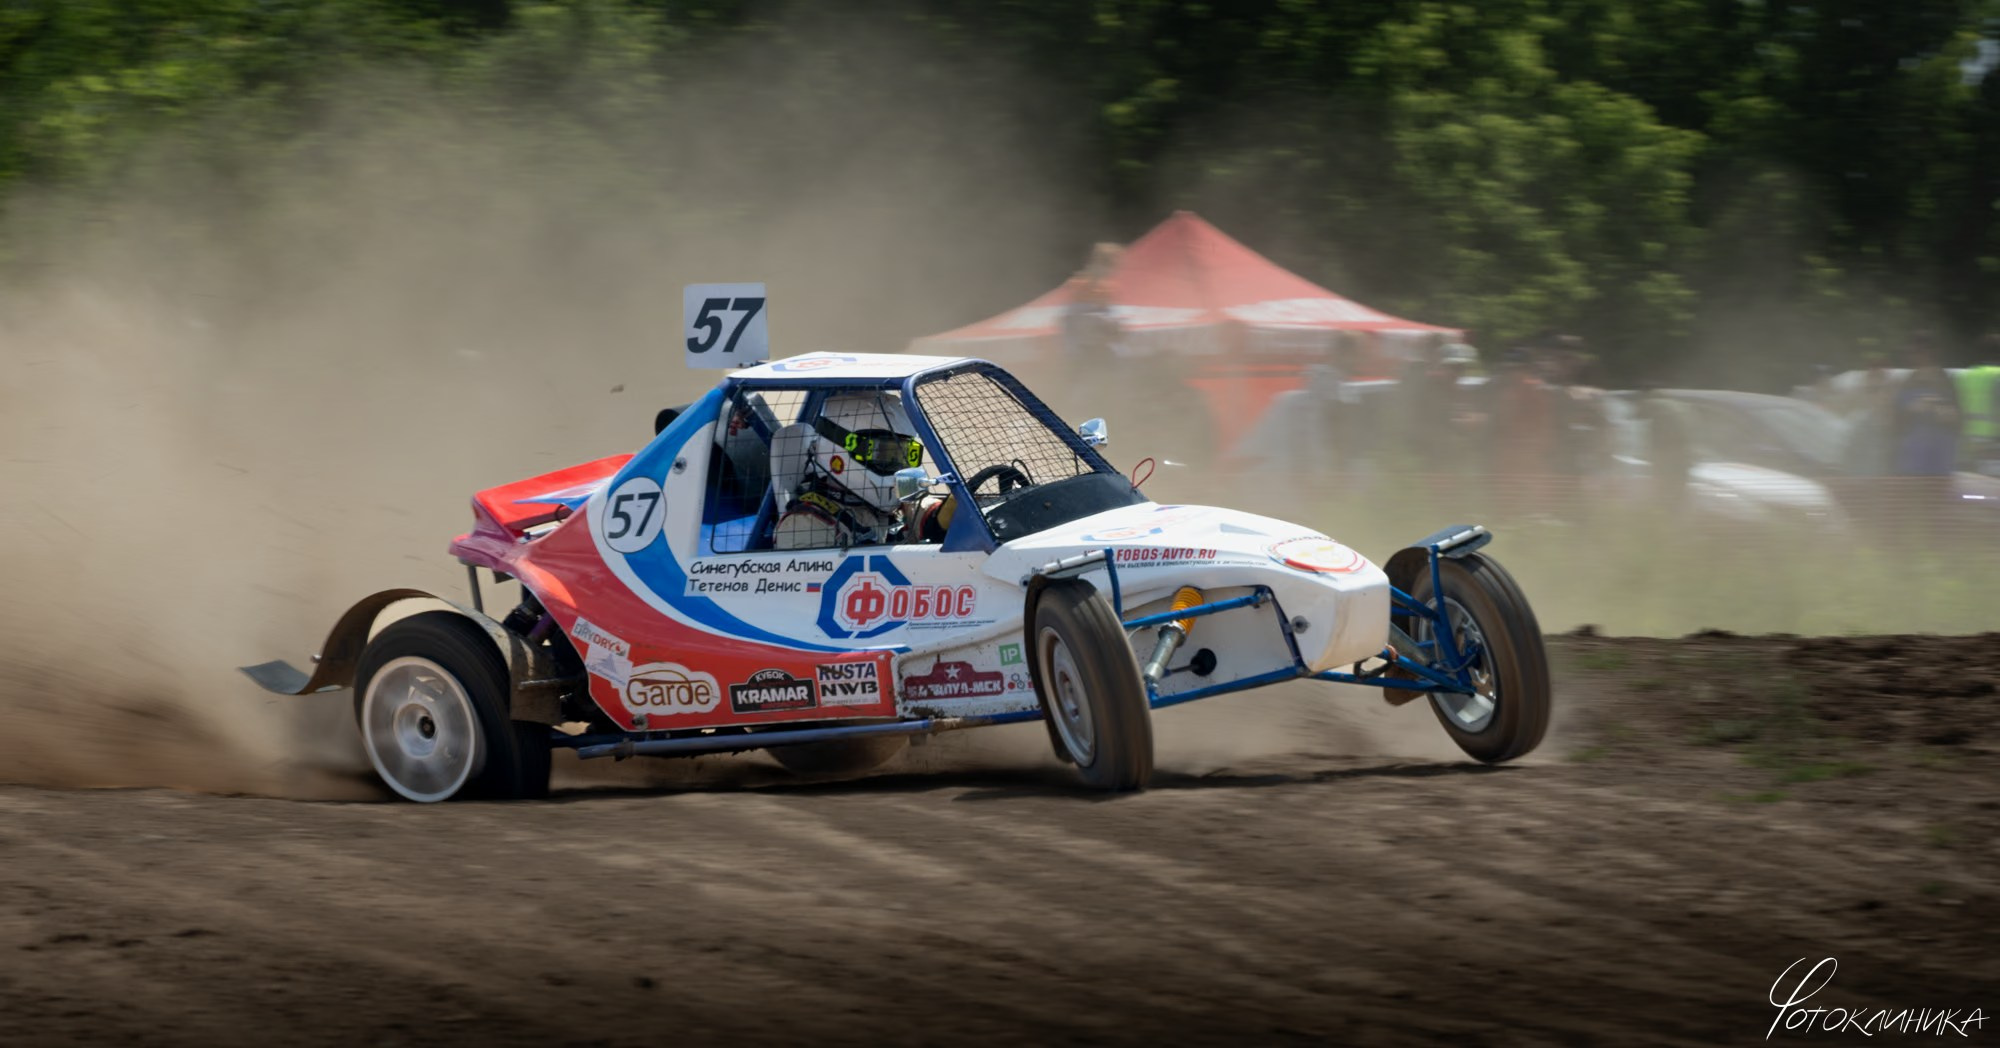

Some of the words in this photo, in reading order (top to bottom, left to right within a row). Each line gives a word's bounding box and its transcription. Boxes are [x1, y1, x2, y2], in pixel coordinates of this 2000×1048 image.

[686, 297, 765, 353] 57
[607, 491, 661, 539] 57
[690, 559, 781, 578] Синегубская
[786, 558, 833, 573] Алина
[689, 578, 749, 592] Тетенов
[755, 578, 802, 594] Денис
[843, 578, 976, 628] ФОБОС
[1003, 648, 1018, 662] IP
[755, 670, 785, 683] КУБОК
[819, 662, 876, 681] RUSTA
[626, 678, 711, 707] Garde
[736, 686, 809, 705] KRAMAR
[821, 680, 878, 697] NWB
